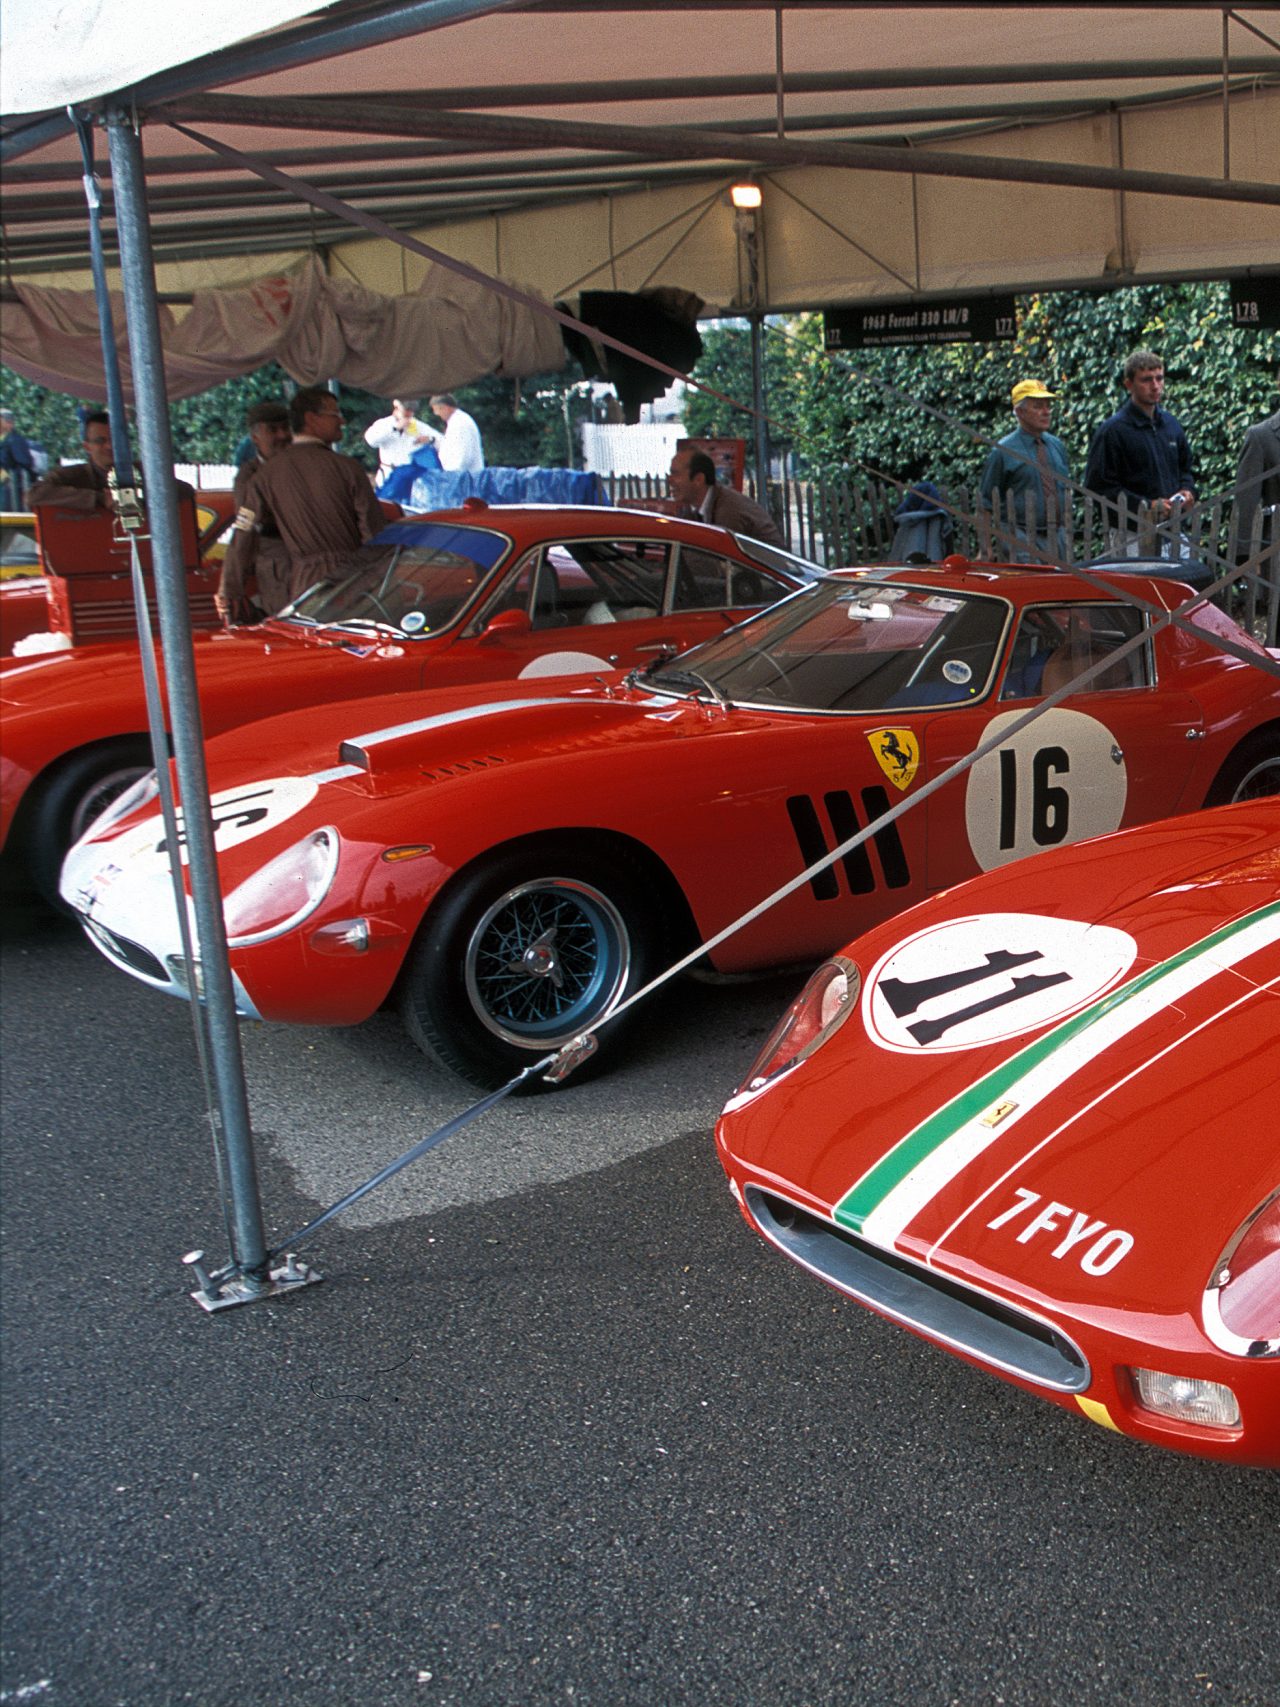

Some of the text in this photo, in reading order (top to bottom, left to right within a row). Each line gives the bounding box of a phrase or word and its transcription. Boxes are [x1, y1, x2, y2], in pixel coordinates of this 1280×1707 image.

[1236, 302, 1258, 316] 178
[999, 745, 1070, 851] 16
[877, 949, 1075, 1046] 11
